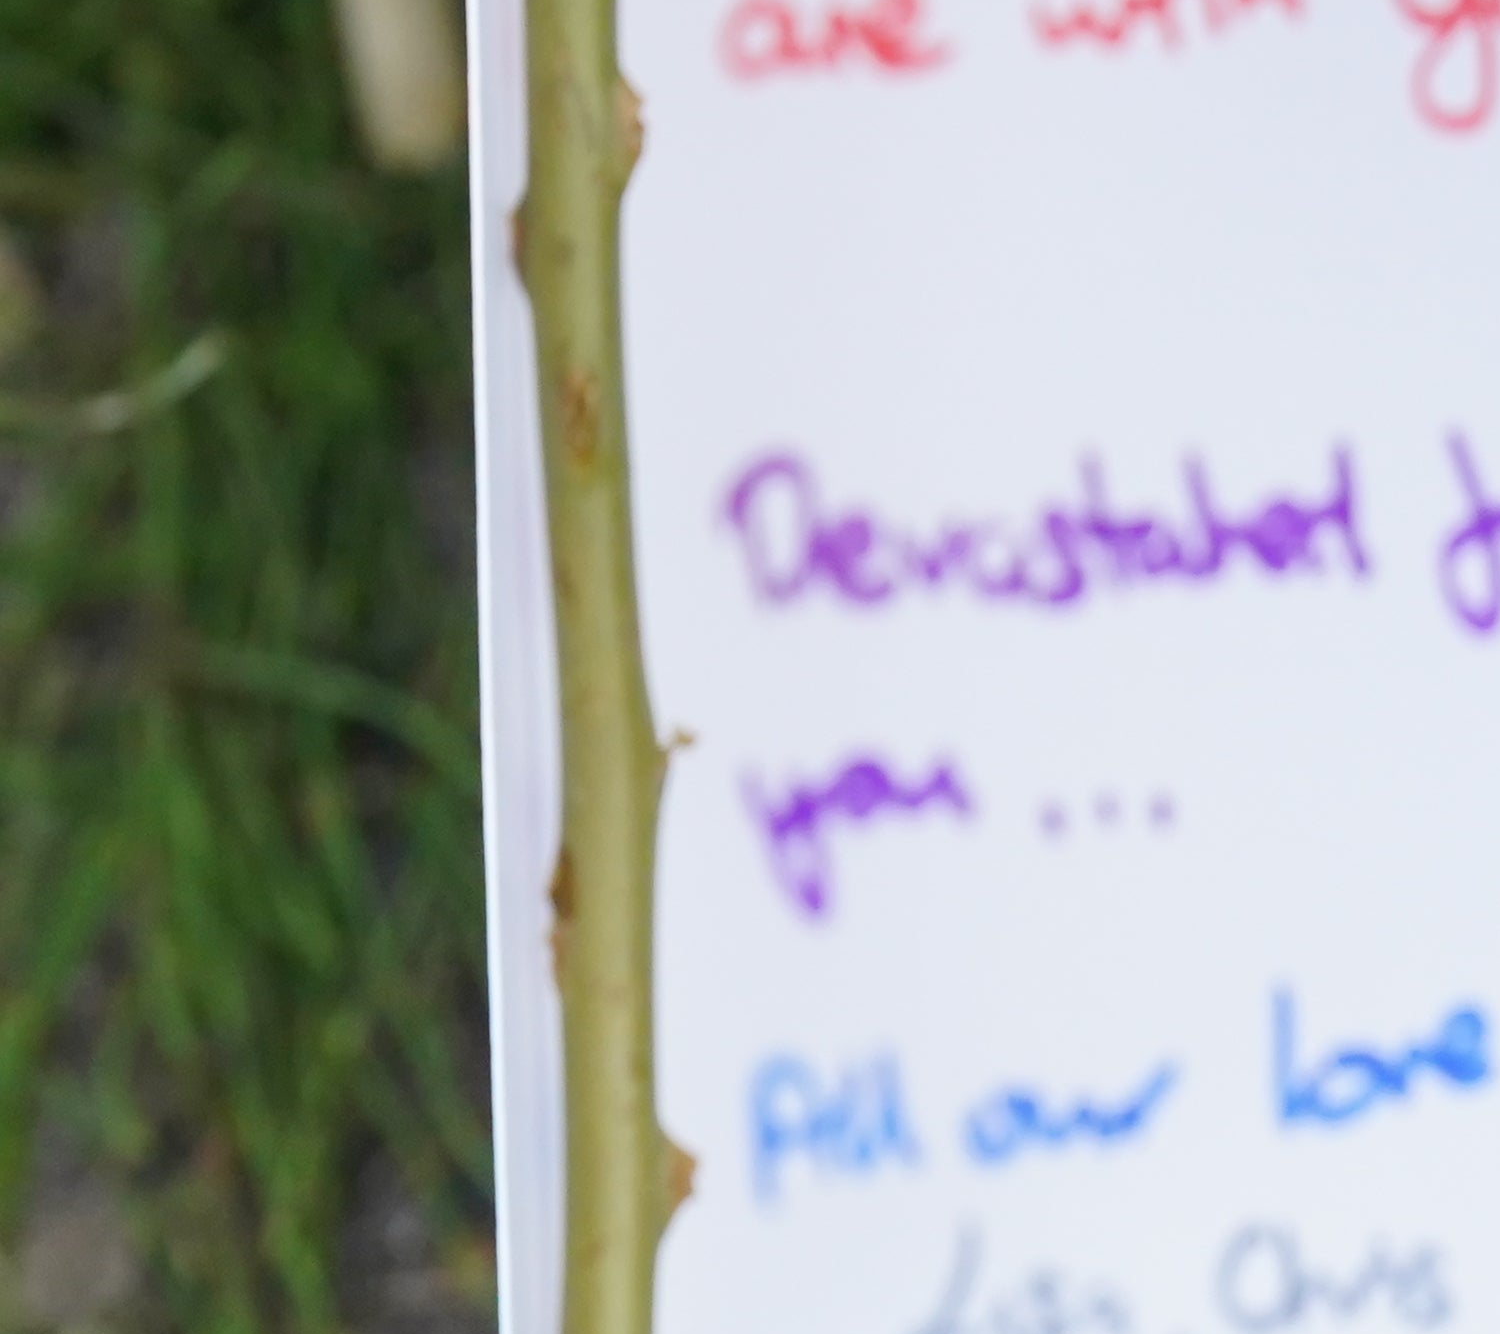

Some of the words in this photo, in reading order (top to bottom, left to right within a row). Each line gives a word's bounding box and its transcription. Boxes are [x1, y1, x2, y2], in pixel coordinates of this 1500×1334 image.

[721, 443, 1370, 609] Devastated
[752, 1055, 920, 1198] All
[965, 1062, 1176, 1164] our
[1269, 981, 1494, 1130] love
